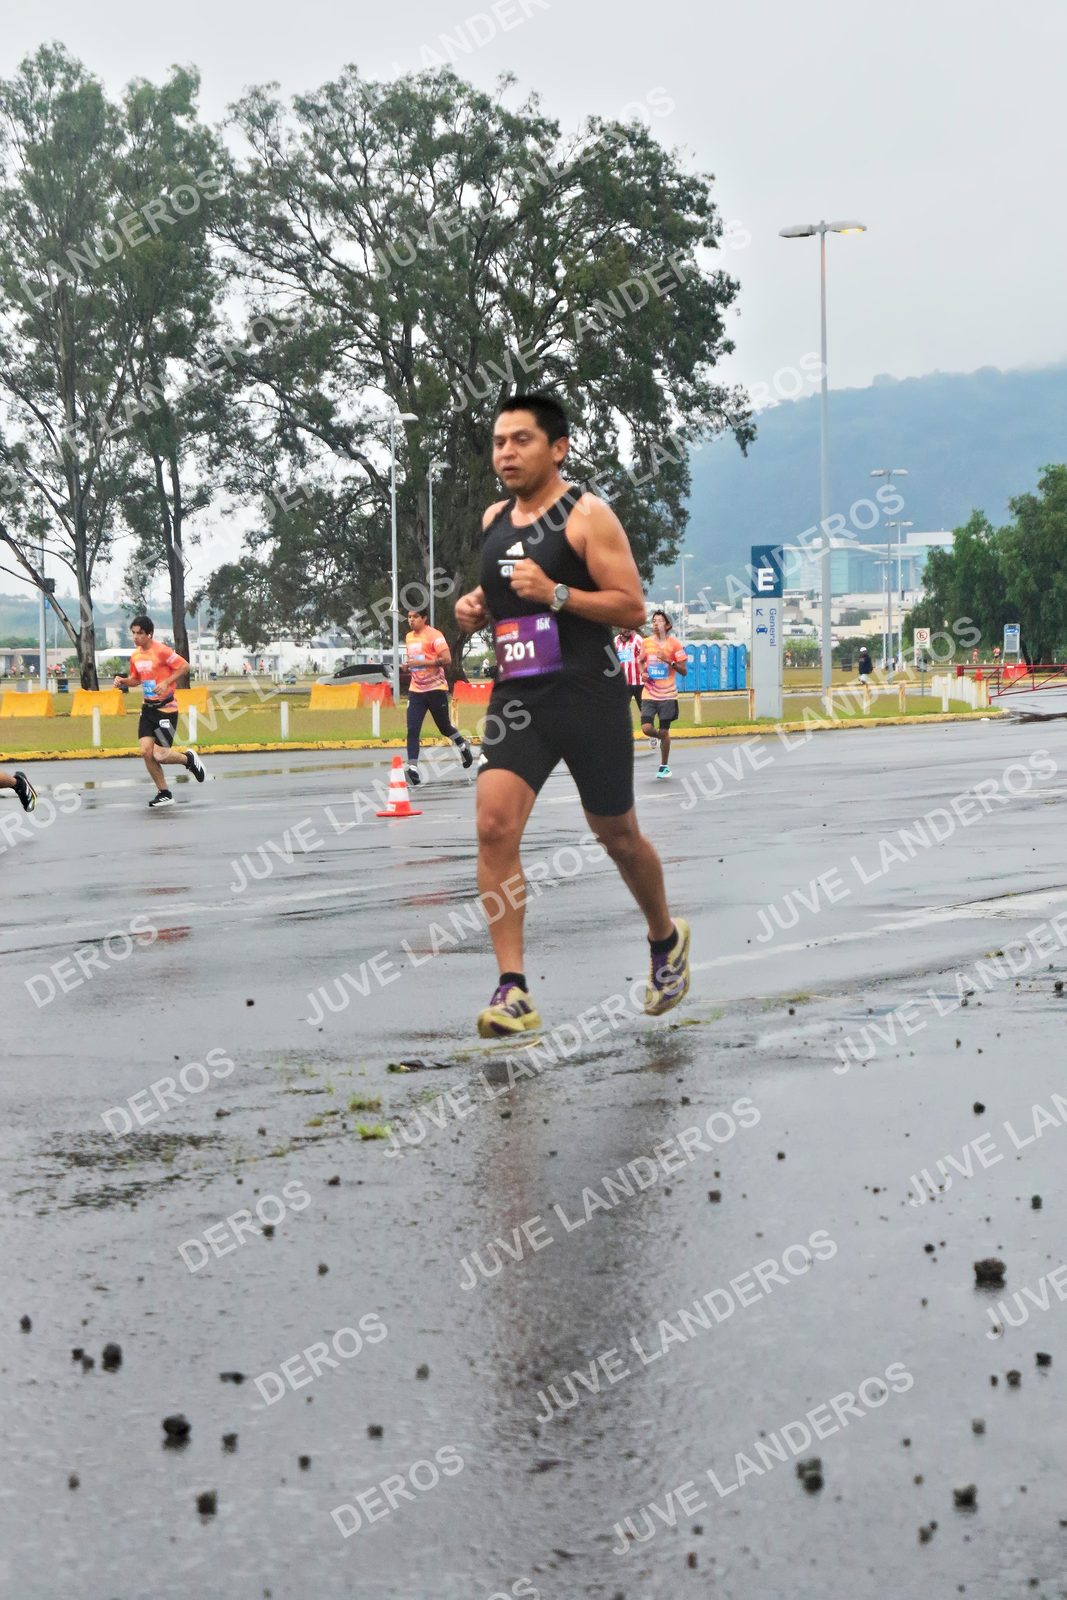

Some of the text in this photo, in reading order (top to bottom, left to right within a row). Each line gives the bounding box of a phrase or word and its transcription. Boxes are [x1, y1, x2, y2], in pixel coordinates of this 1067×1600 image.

[758, 568, 774, 591] E
[769, 608, 777, 647] General
[504, 641, 536, 662] 201
